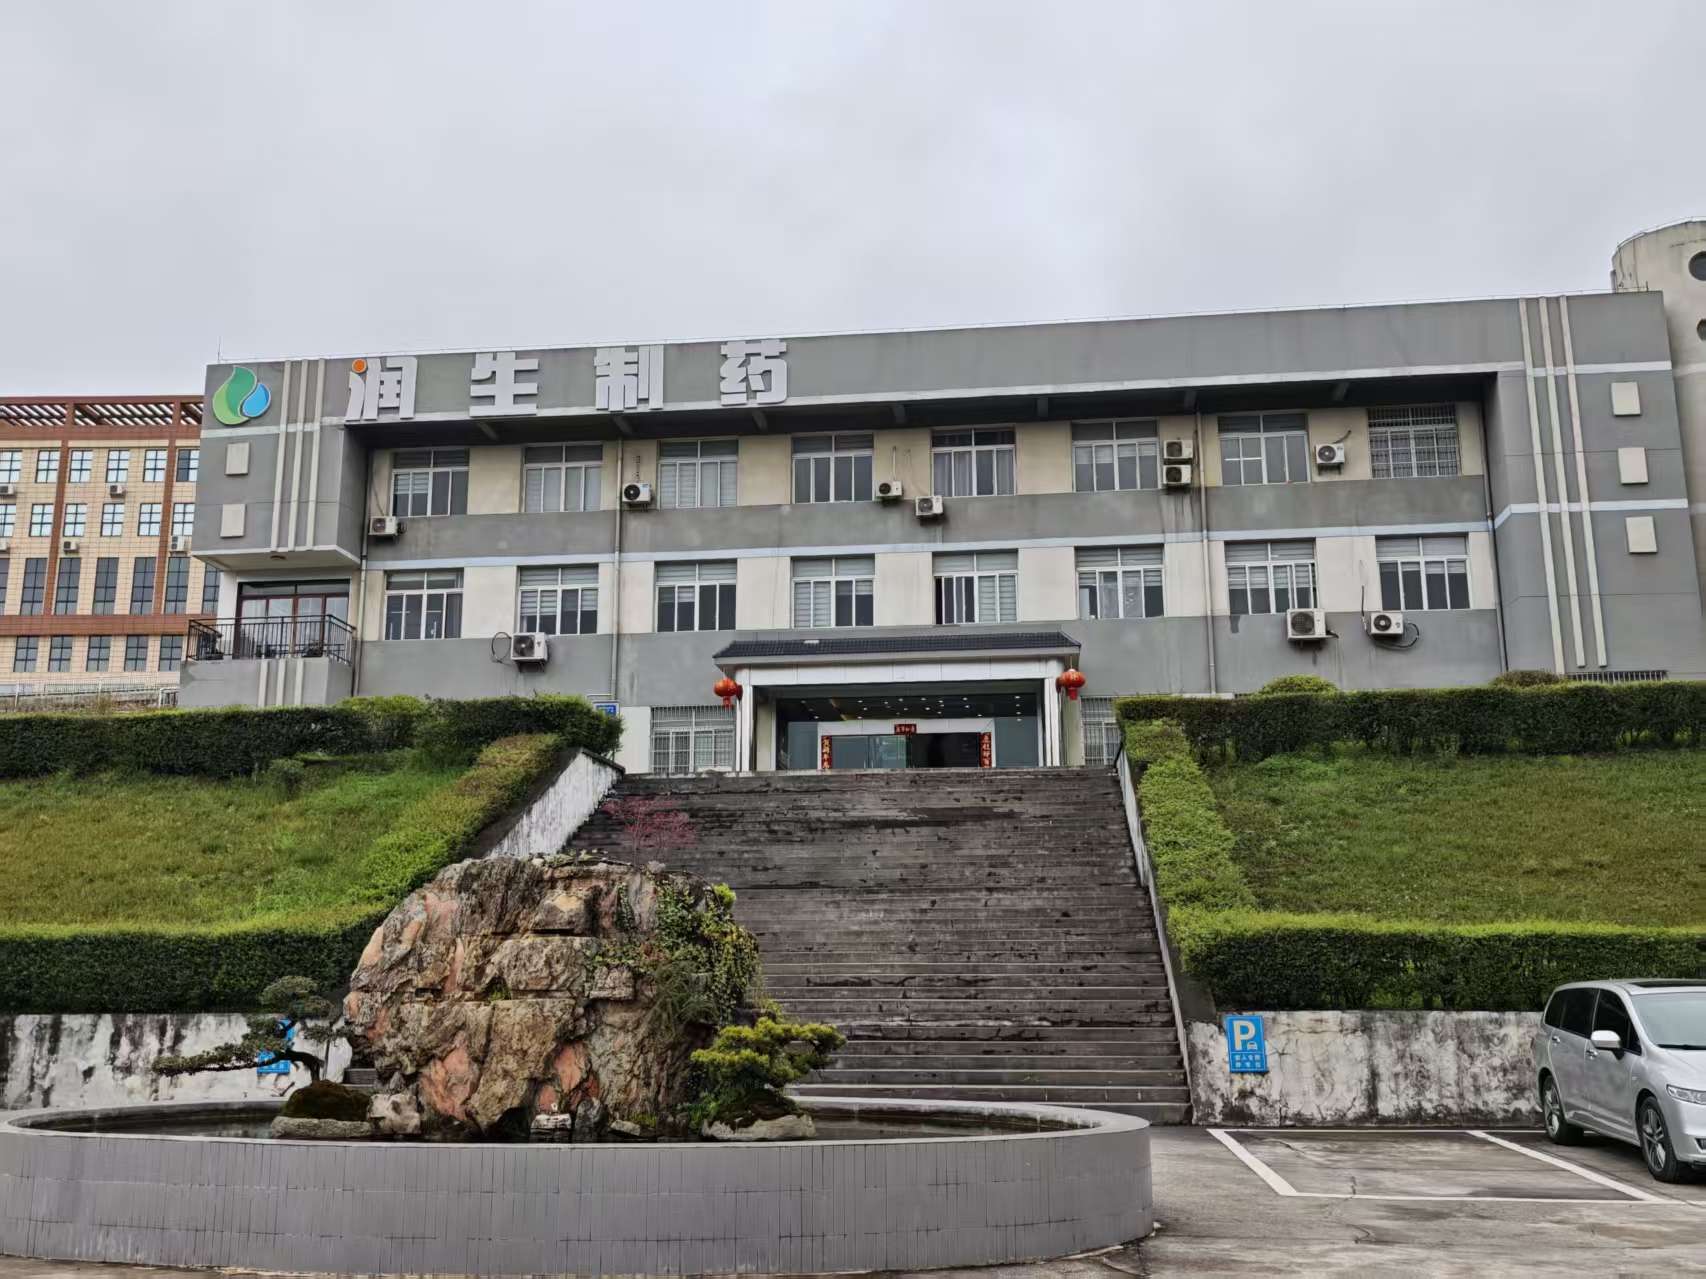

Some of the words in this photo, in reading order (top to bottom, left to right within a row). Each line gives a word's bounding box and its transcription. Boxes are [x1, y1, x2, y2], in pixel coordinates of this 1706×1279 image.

[345, 339, 788, 421] 润生制药
[1233, 1020, 1256, 1051] P
